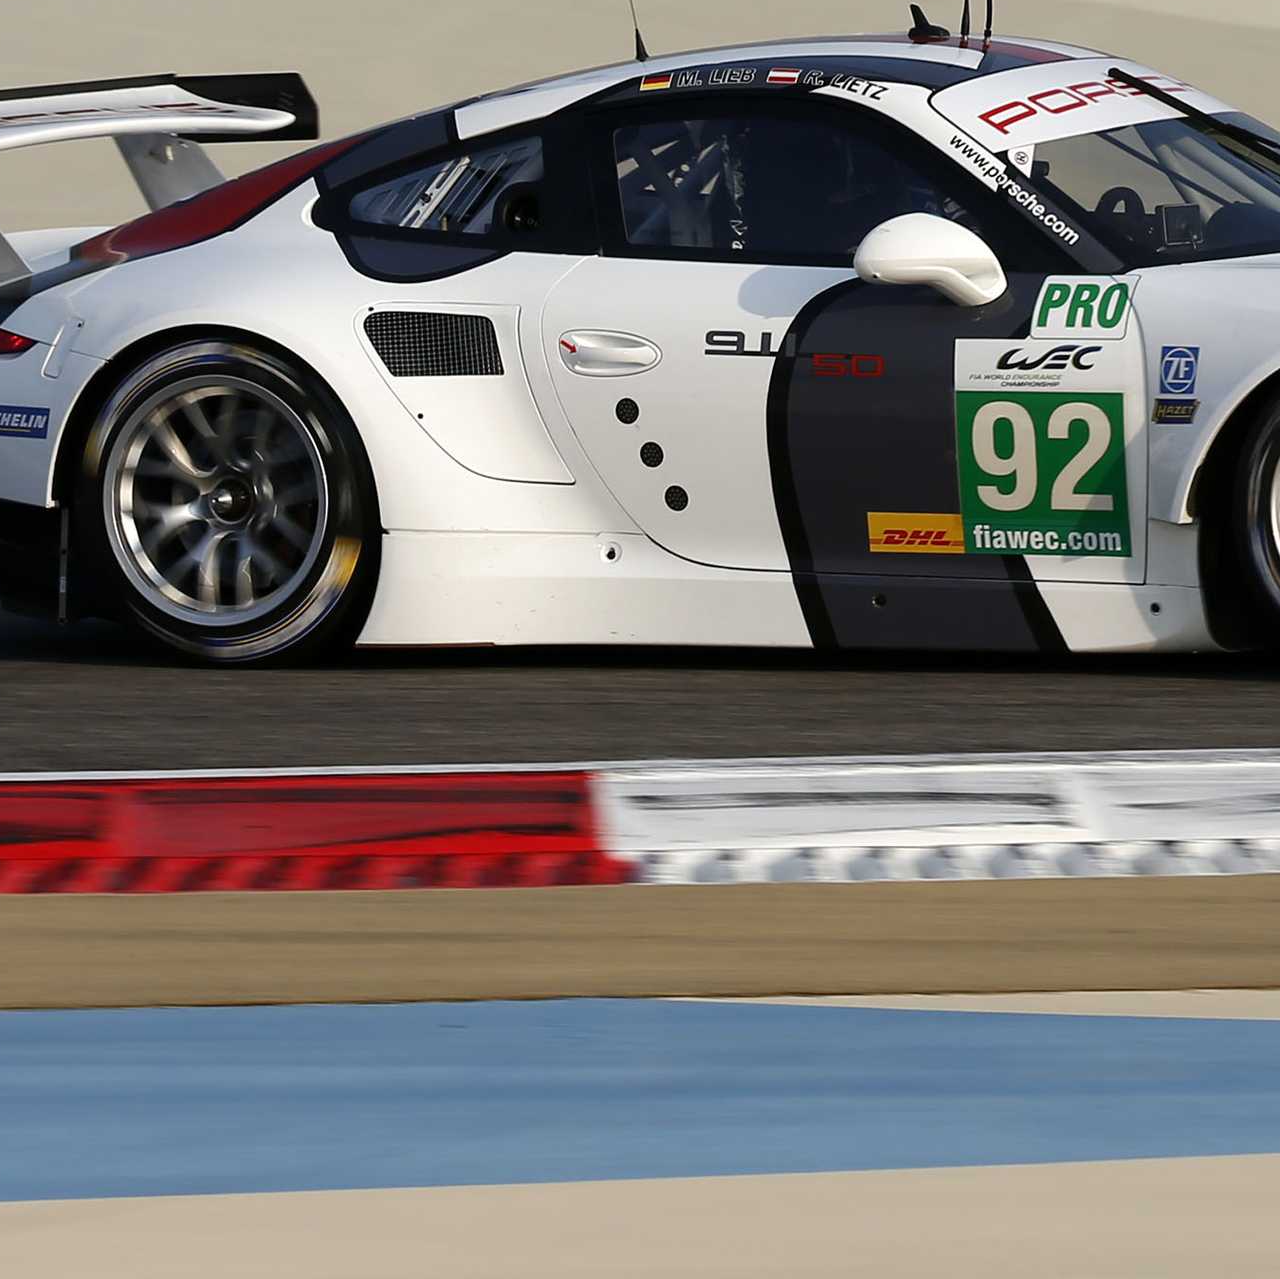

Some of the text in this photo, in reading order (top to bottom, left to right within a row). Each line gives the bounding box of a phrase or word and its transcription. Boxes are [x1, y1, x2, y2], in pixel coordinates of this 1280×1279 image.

[677, 67, 757, 87] M. LIEB
[803, 70, 889, 100] R. LIETZ
[949, 135, 1080, 246] www.porsche.com
[1036, 283, 1129, 329] PRO
[813, 354, 884, 377] 50
[996, 344, 1103, 370] WEC
[972, 401, 1114, 511] 92
[882, 529, 952, 546] DHL
[973, 524, 1122, 551] fiawec.com
